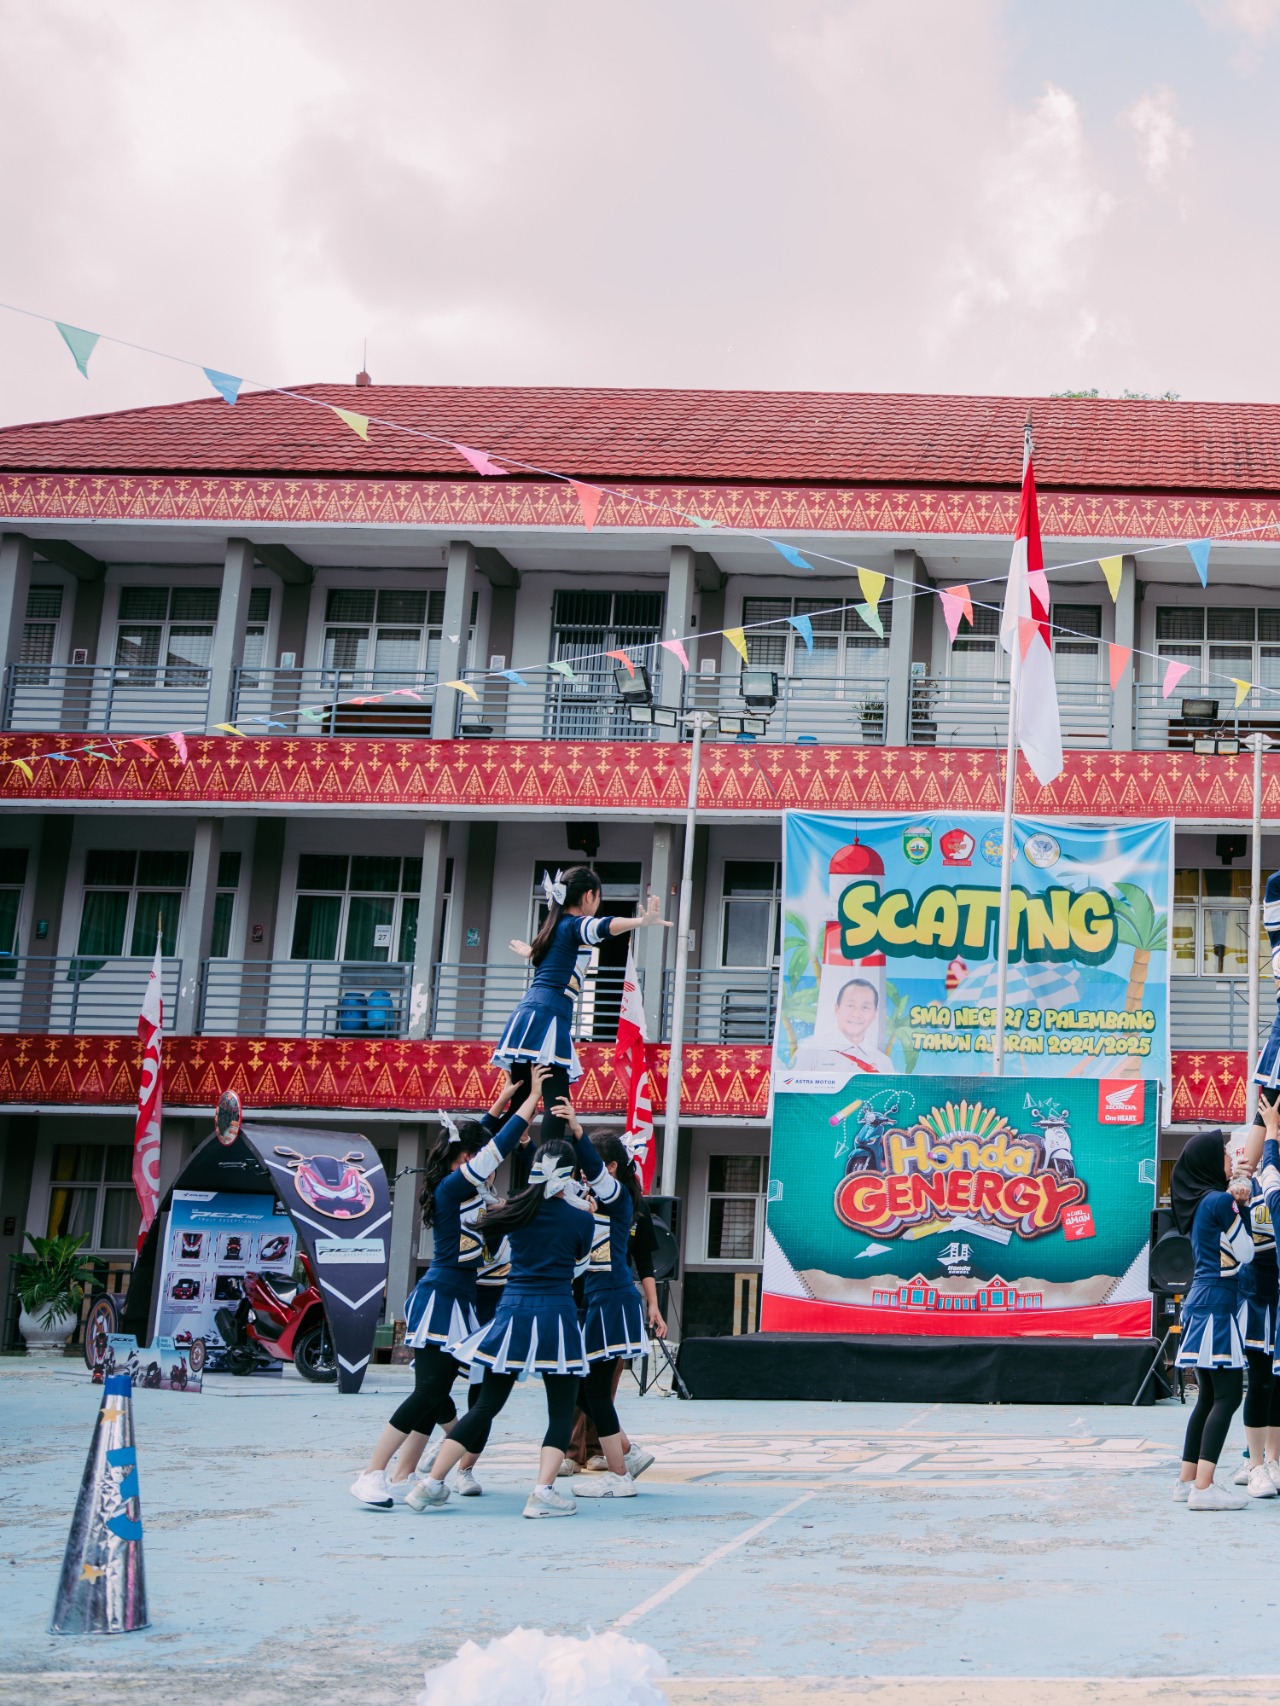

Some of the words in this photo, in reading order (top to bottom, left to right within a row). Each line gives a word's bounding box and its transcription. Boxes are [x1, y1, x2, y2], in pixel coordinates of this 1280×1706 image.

[909, 1006, 951, 1028] SMA
[1027, 1009, 1041, 1030] 3
[1045, 1010, 1155, 1032] PALEMBANG
[912, 1033, 971, 1051] TAHUN
[1048, 1036, 1152, 1056] 2024/2025
[890, 1132, 1034, 1175] Honda
[840, 1170, 1081, 1225] GENERGY
